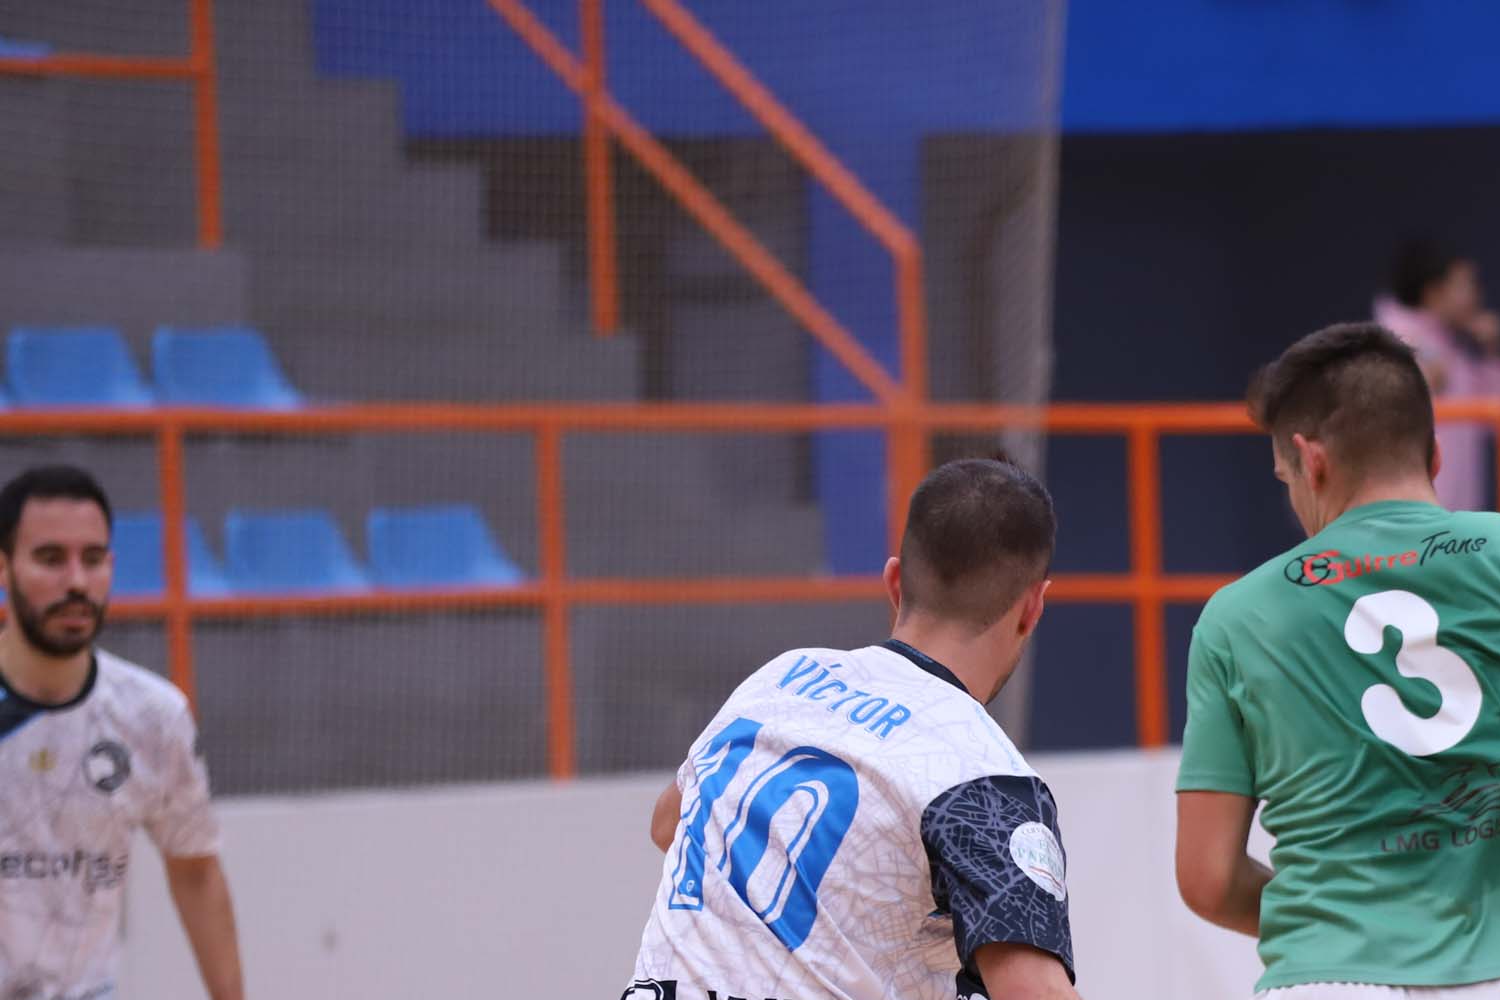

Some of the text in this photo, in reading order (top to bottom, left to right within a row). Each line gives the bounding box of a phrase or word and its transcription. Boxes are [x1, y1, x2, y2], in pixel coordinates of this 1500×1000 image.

[1303, 530, 1488, 585] Guirre Trans
[776, 654, 912, 741] VÍCTOR
[1344, 589, 1483, 757] 3
[668, 716, 859, 952] 10
[1380, 828, 1441, 853] LMG
